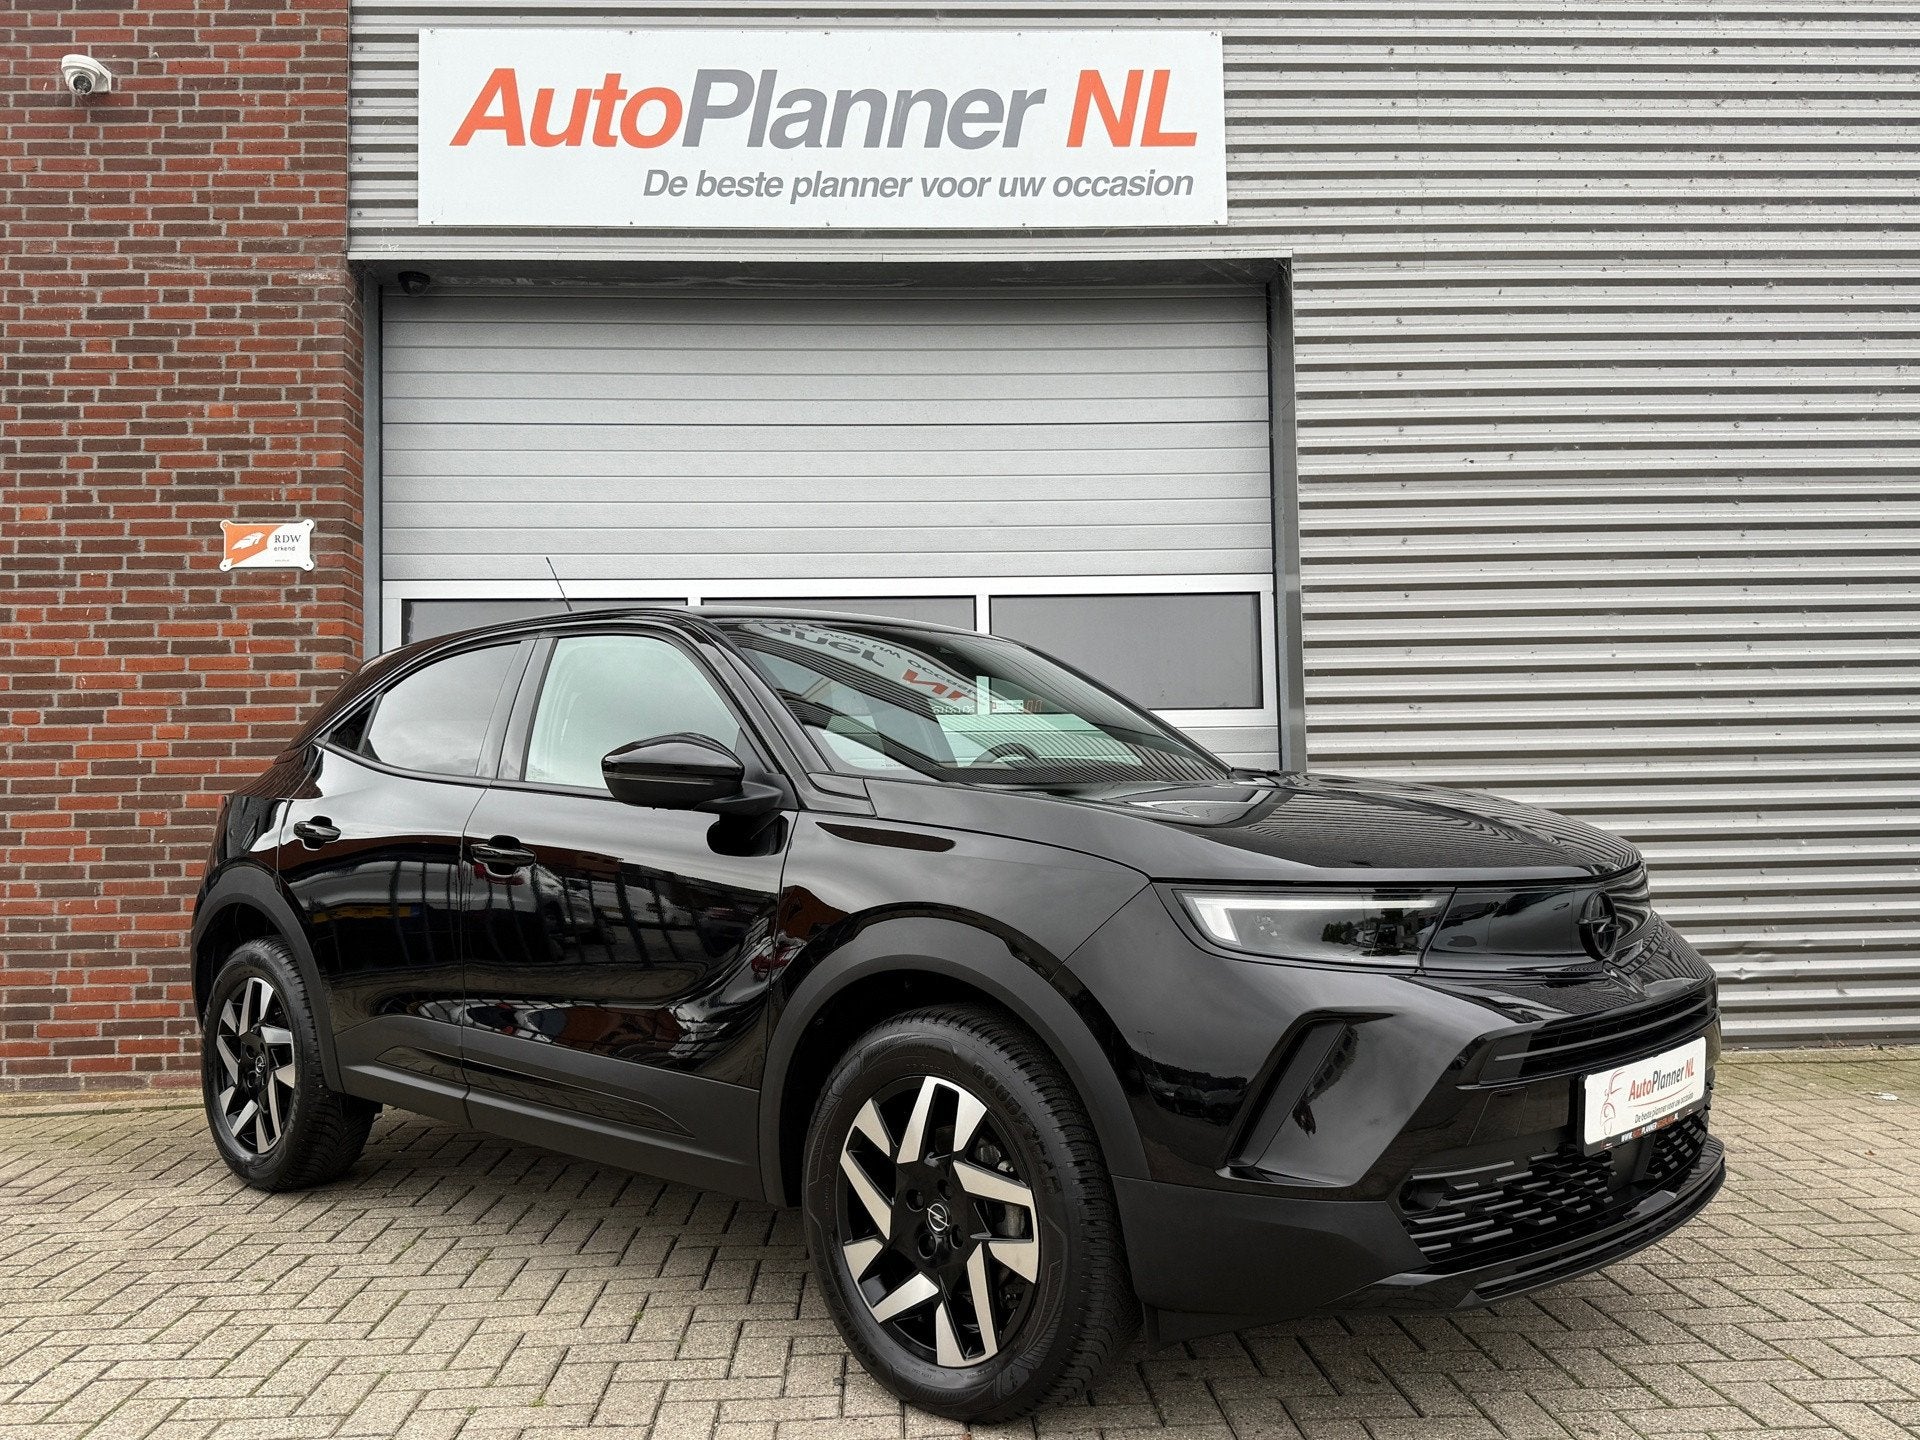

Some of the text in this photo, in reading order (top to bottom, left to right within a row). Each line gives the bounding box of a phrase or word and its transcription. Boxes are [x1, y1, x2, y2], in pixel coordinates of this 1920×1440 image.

[449, 68, 1197, 149] AutoPlanner NL
[644, 169, 1193, 204] De beste planner voor uw occasion
[274, 535, 301, 543] RDW
[1628, 1057, 1695, 1101] AutoPlanner NL
